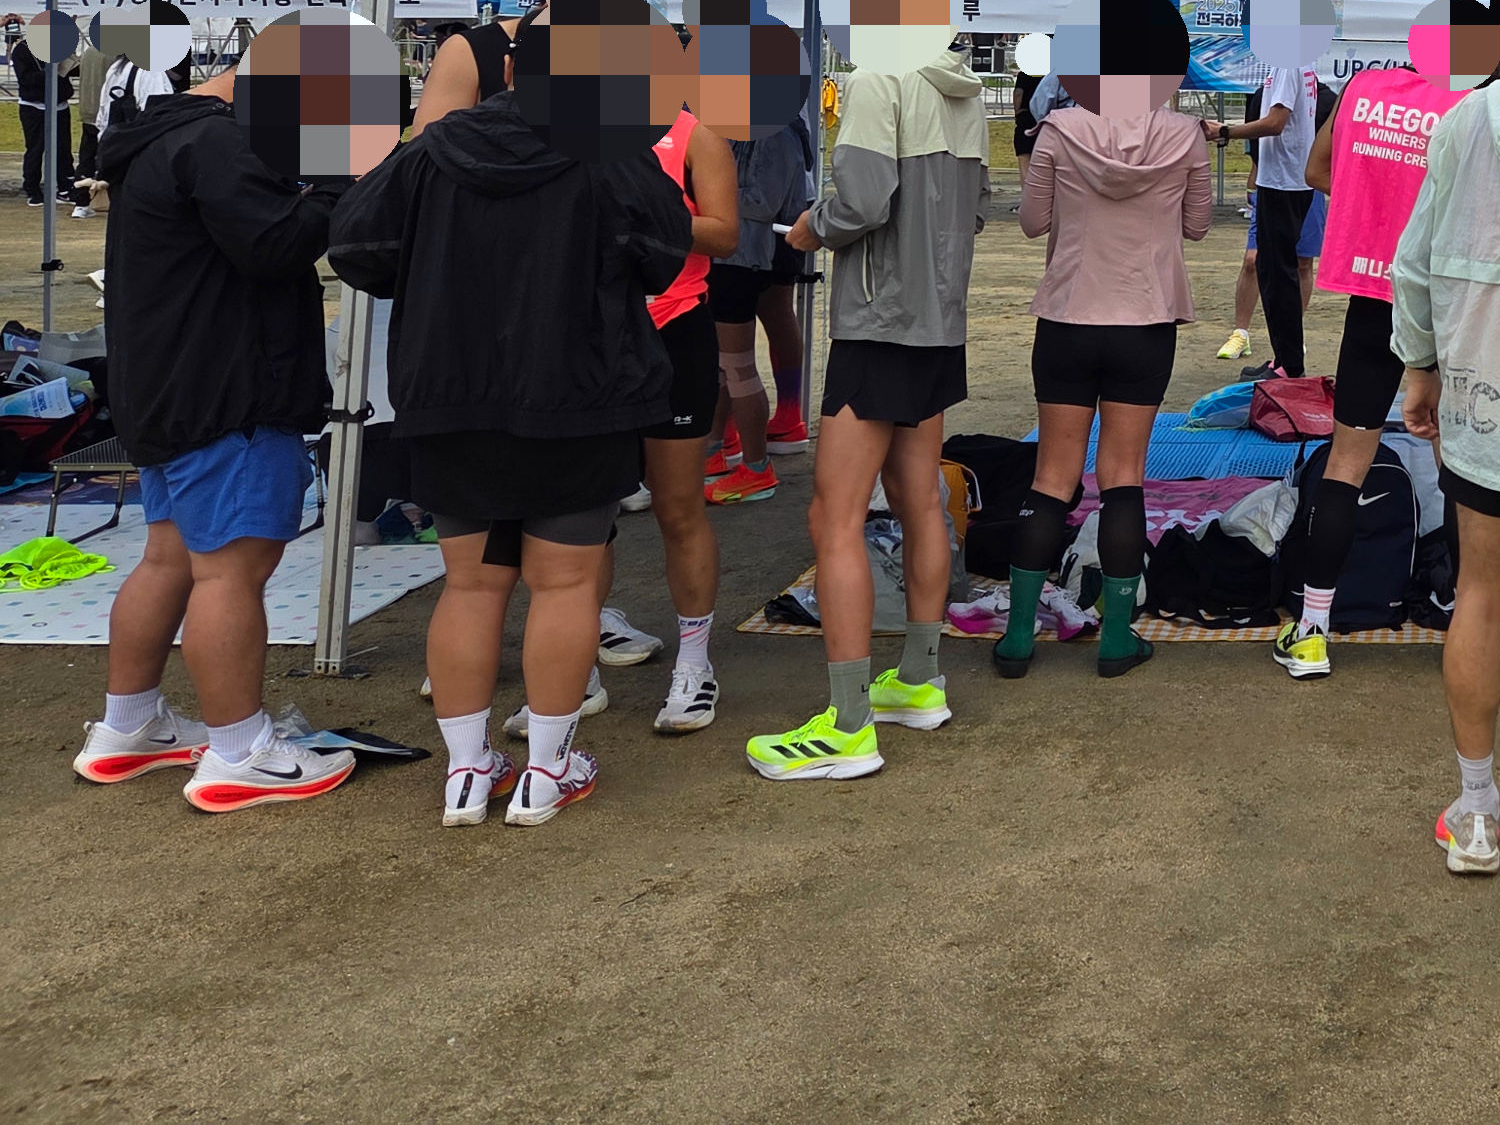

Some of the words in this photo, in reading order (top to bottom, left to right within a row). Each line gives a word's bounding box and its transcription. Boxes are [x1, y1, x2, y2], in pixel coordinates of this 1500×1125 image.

[1353, 97, 1441, 137] BAEGO
[1369, 126, 1427, 150] WINNERS
[1352, 141, 1402, 162] RUNNING
[1404, 152, 1428, 169] CRE
